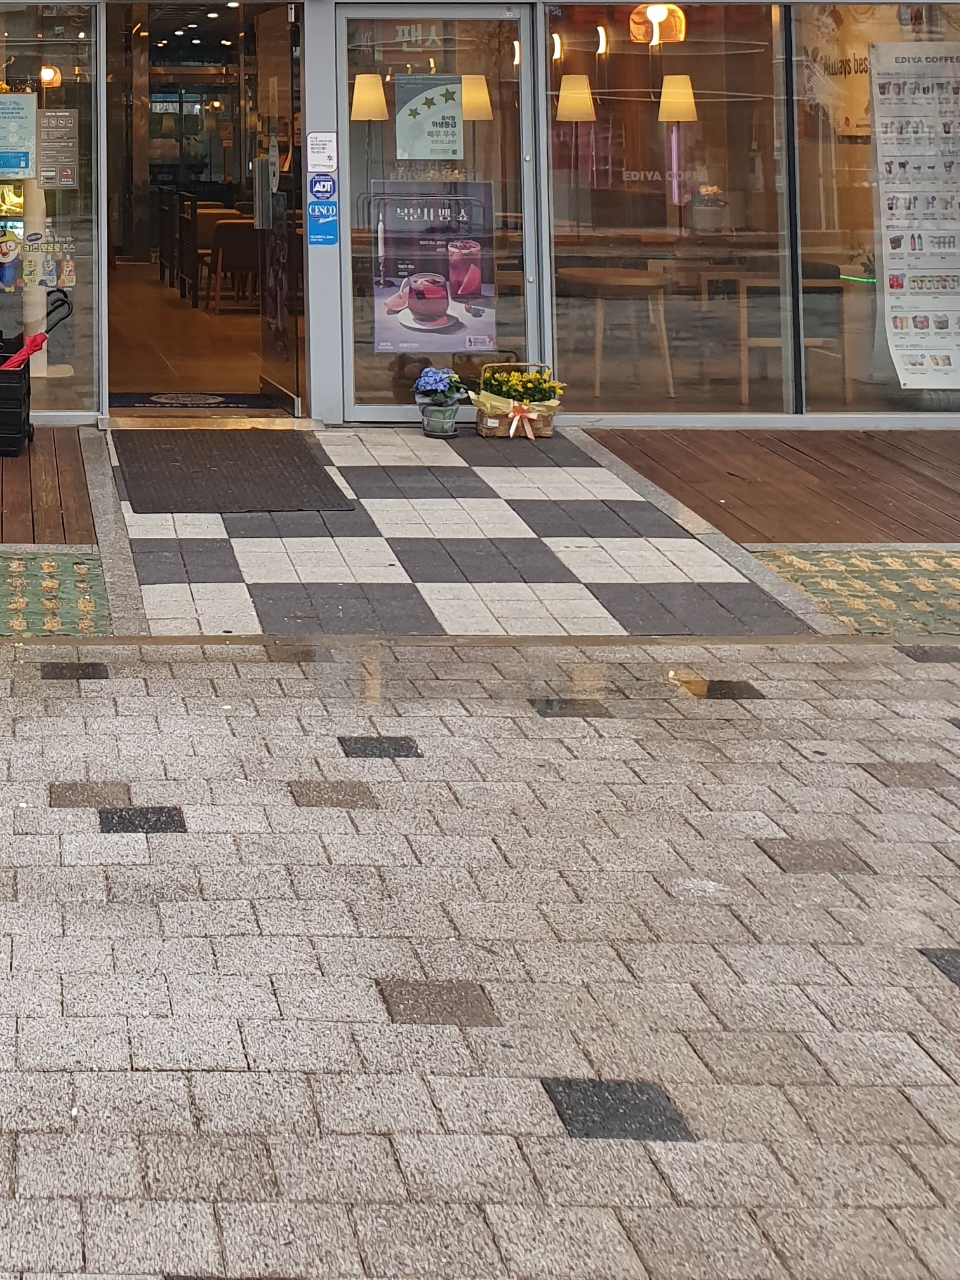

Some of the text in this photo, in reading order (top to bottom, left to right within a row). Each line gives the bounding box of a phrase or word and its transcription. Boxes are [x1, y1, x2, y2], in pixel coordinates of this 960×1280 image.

[853, 53, 868, 74] bes
[623, 171, 662, 181] EDIYA
[313, 182, 332, 192] ADT
[309, 205, 336, 216] CESCO
